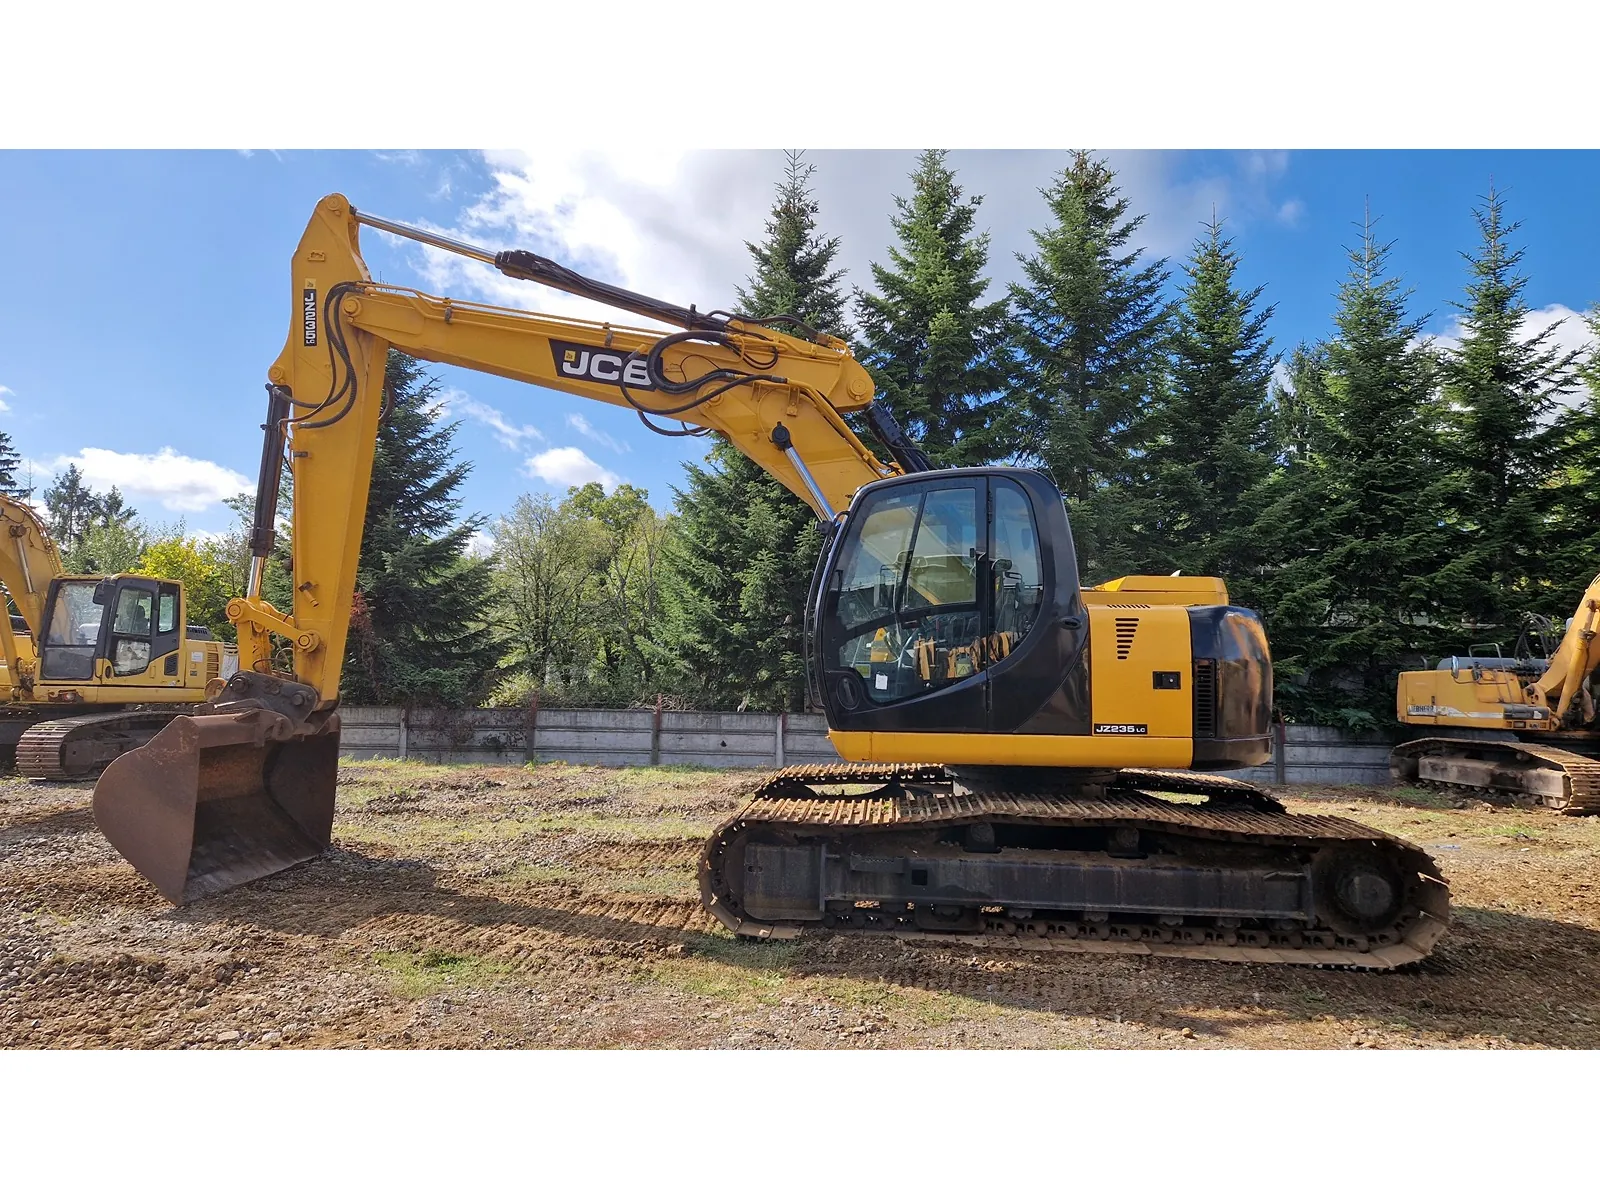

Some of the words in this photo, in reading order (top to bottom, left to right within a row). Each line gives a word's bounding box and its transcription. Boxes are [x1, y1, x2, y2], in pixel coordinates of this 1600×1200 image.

[305, 293, 316, 339] JZ235
[562, 351, 652, 386] JCB
[1096, 725, 1135, 733] JZ235
